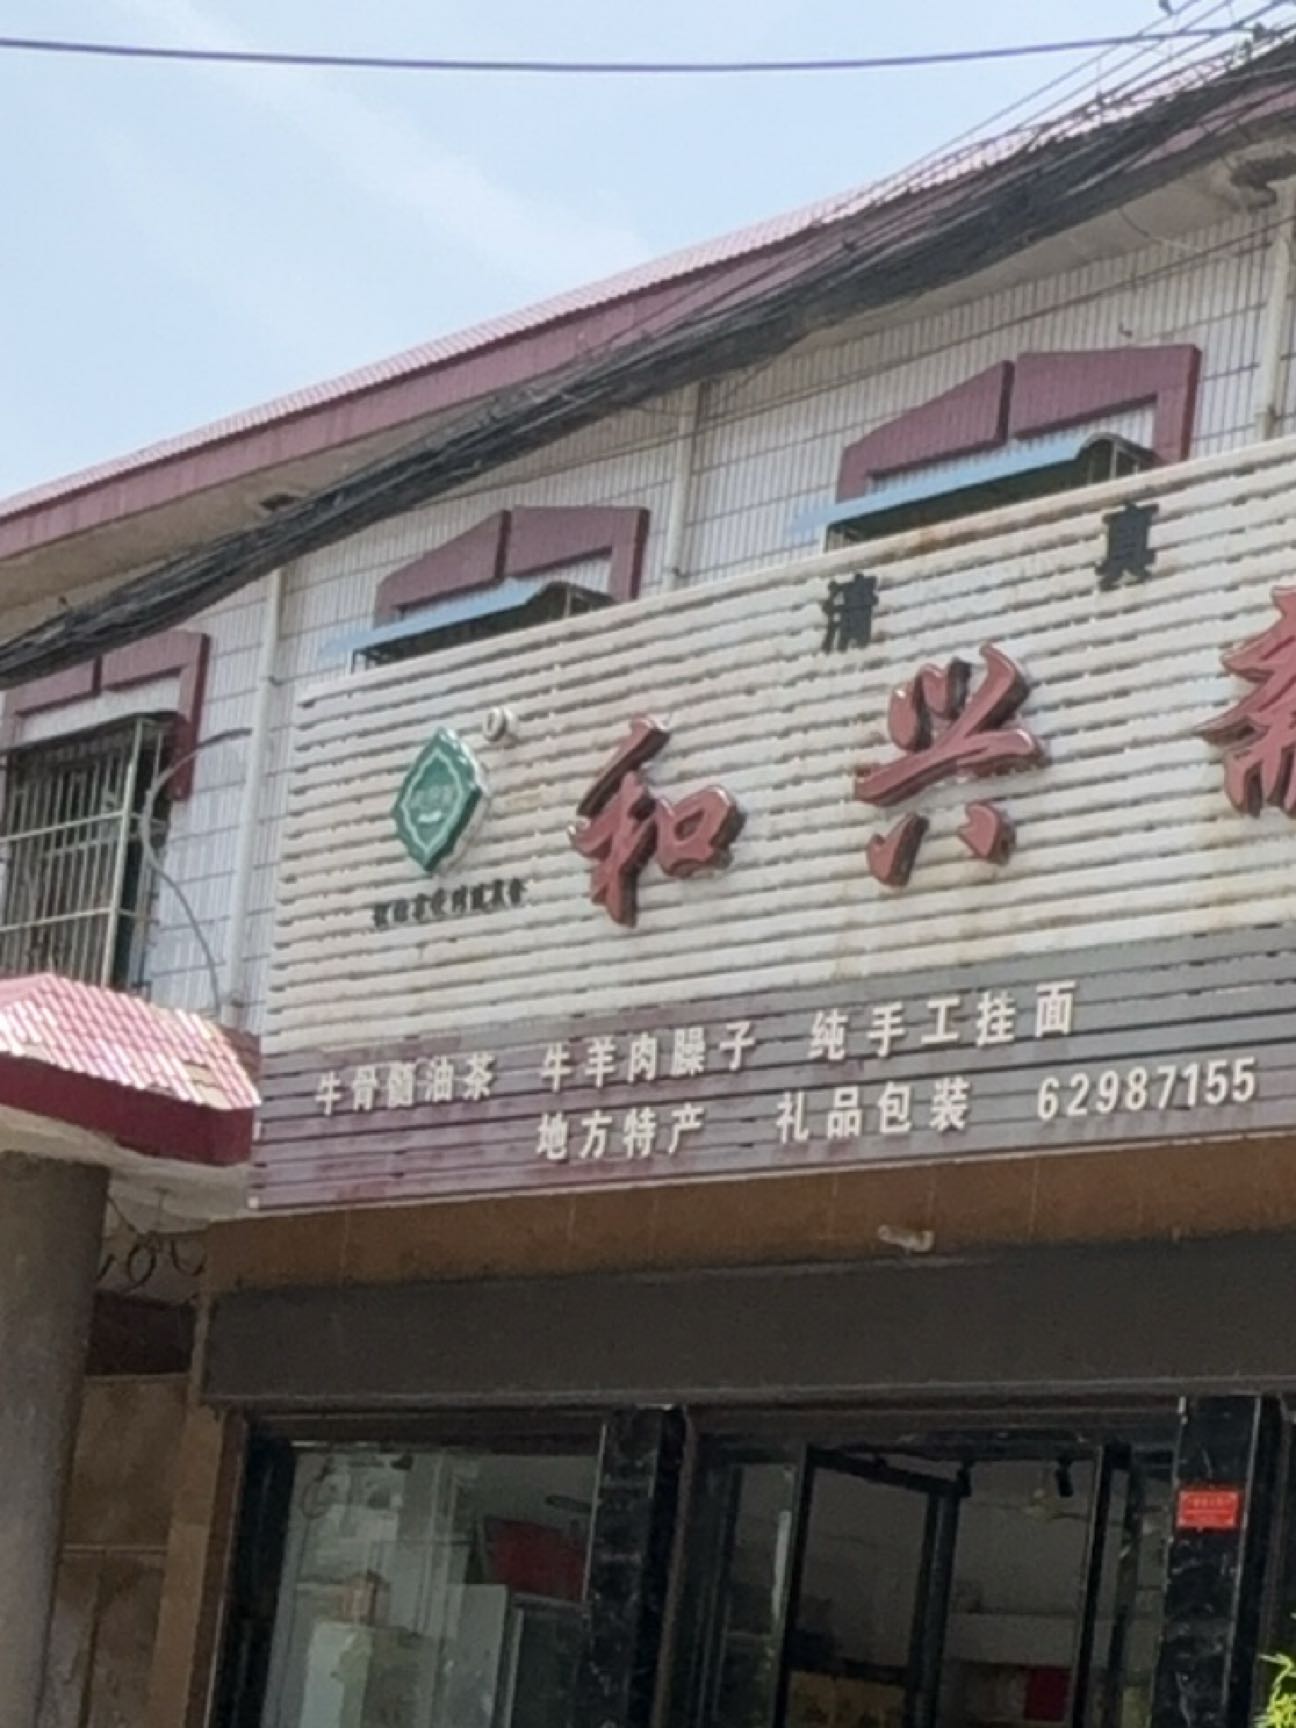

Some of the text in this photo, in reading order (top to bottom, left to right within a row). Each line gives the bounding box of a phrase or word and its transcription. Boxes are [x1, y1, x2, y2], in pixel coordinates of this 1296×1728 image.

[540, 1021, 756, 1092] 牛羊肉臊子
[807, 980, 1076, 1061] 纯手工挂面
[537, 1057, 1256, 1161] 地方特产 礼品包装 62987155
